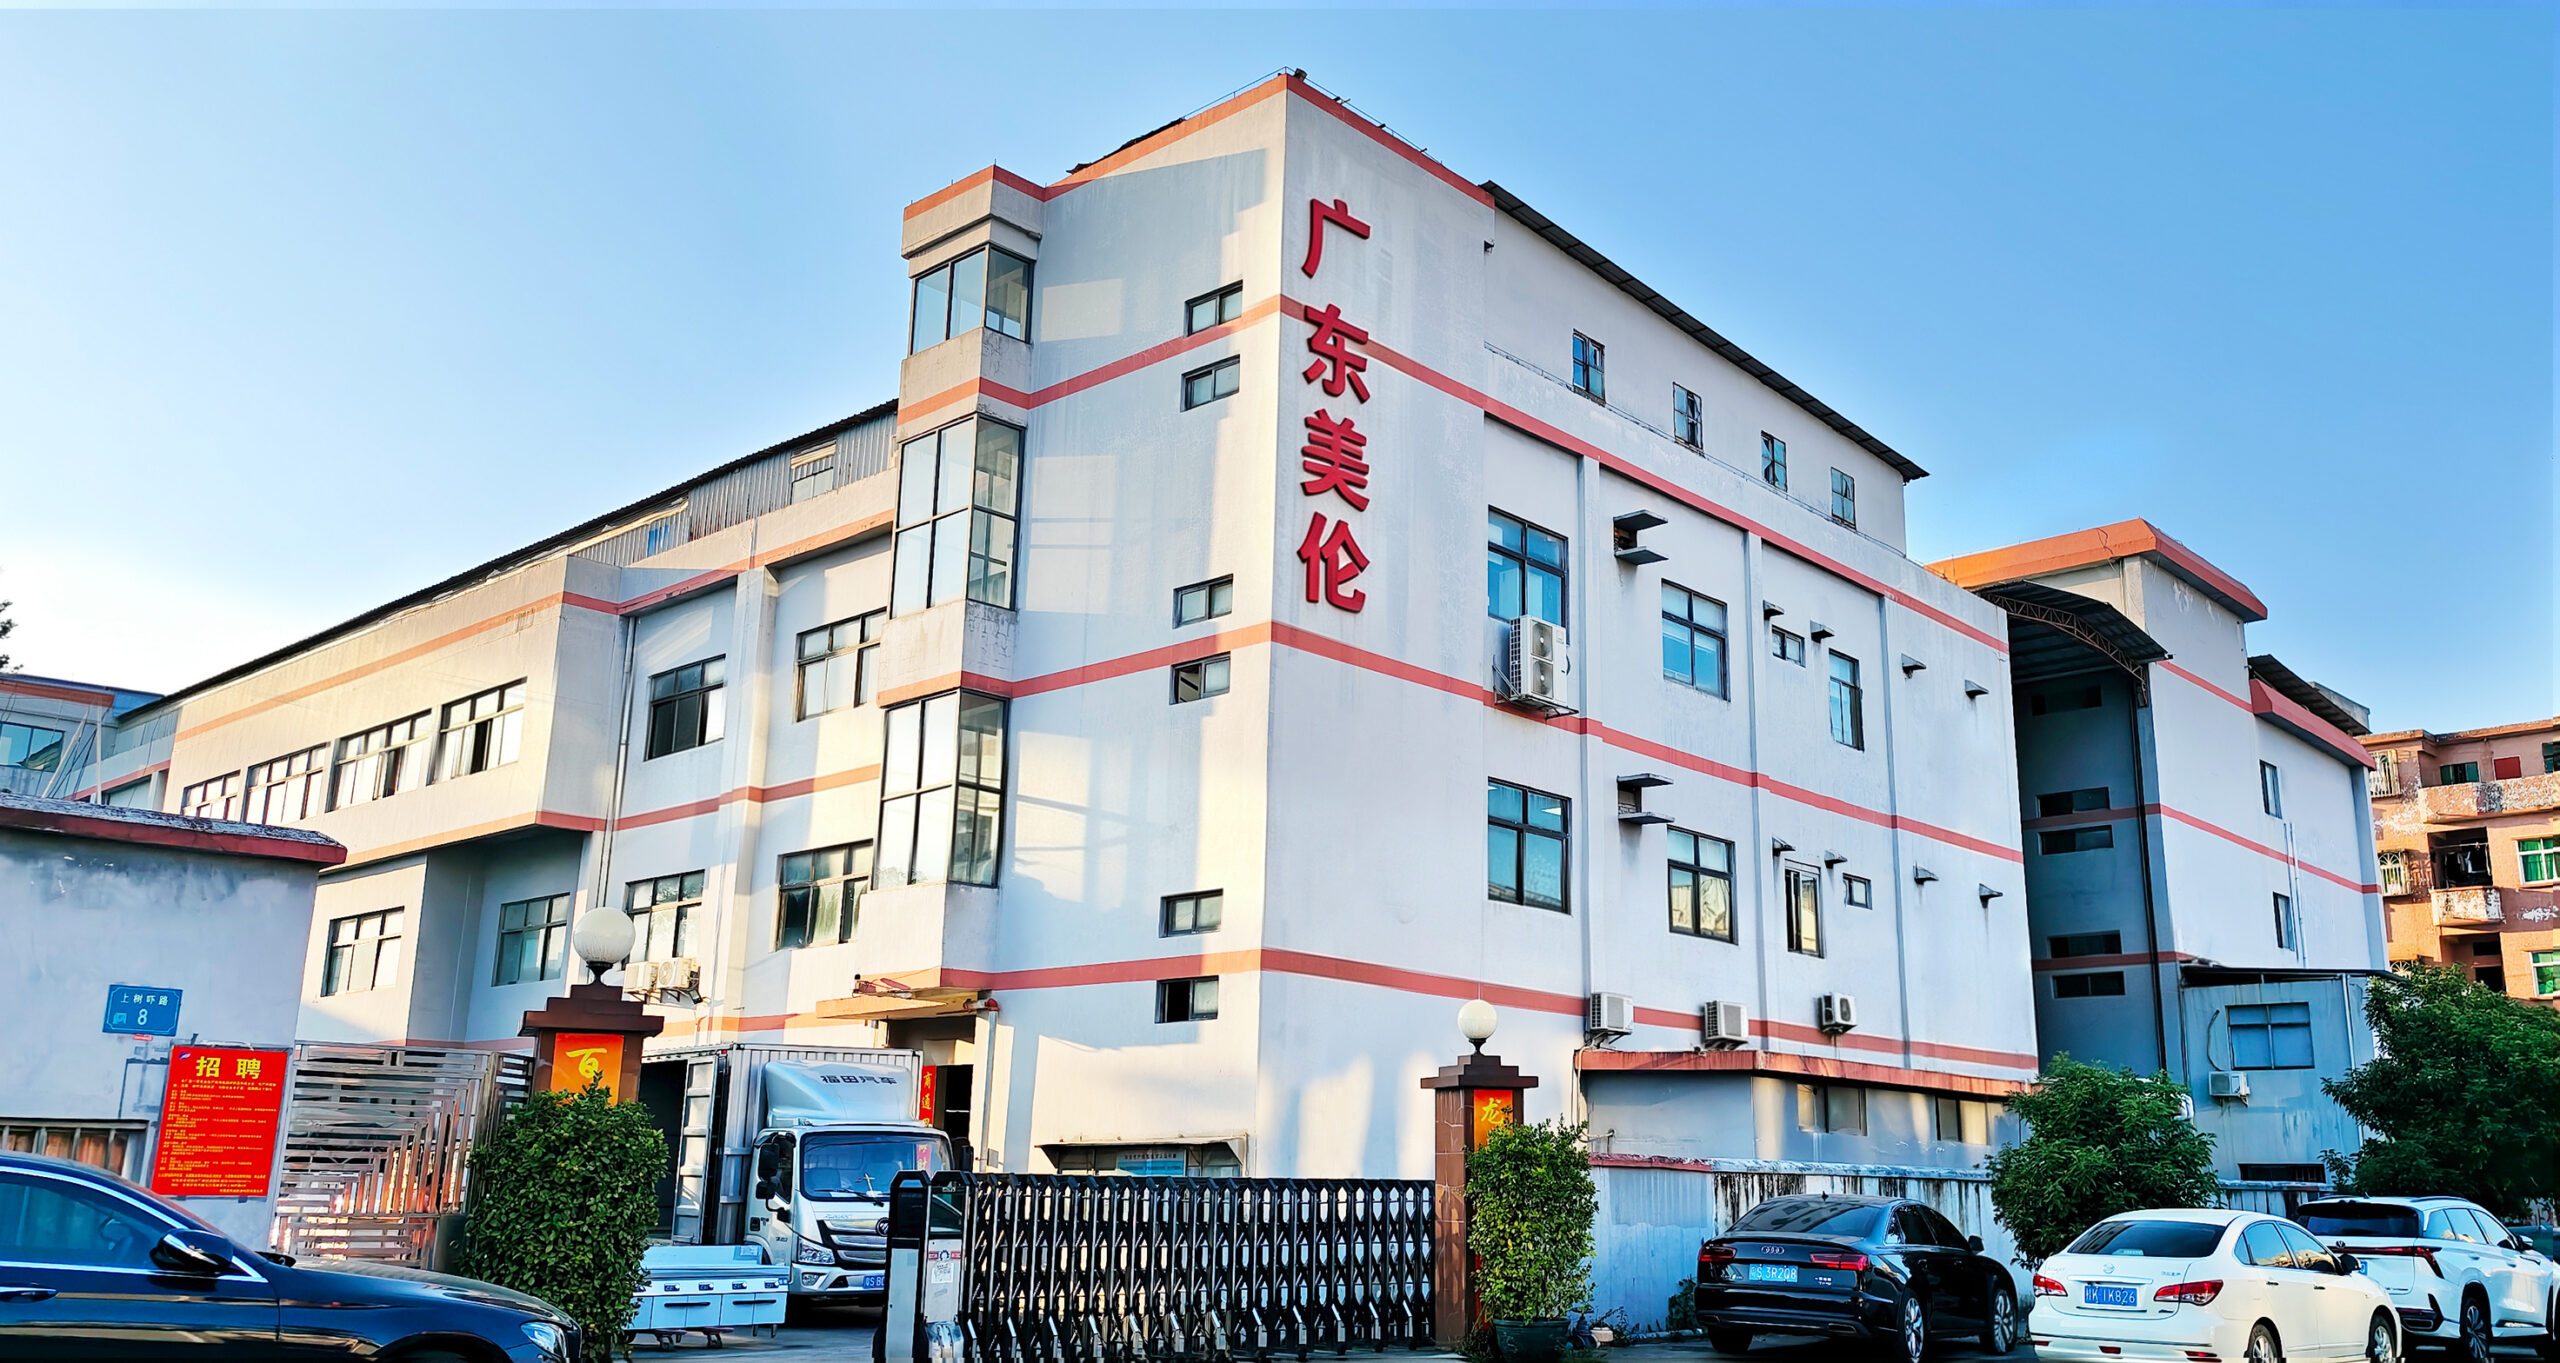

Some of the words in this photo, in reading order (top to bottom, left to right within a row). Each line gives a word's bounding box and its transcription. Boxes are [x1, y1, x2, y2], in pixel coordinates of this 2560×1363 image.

[1297, 199, 1370, 613] 广东美伦
[137, 1008, 148, 1025] 8
[196, 1056, 261, 1079] 招聘
[820, 1075, 897, 1084] 福田汽车
[1481, 1097, 1504, 1125] 龙
